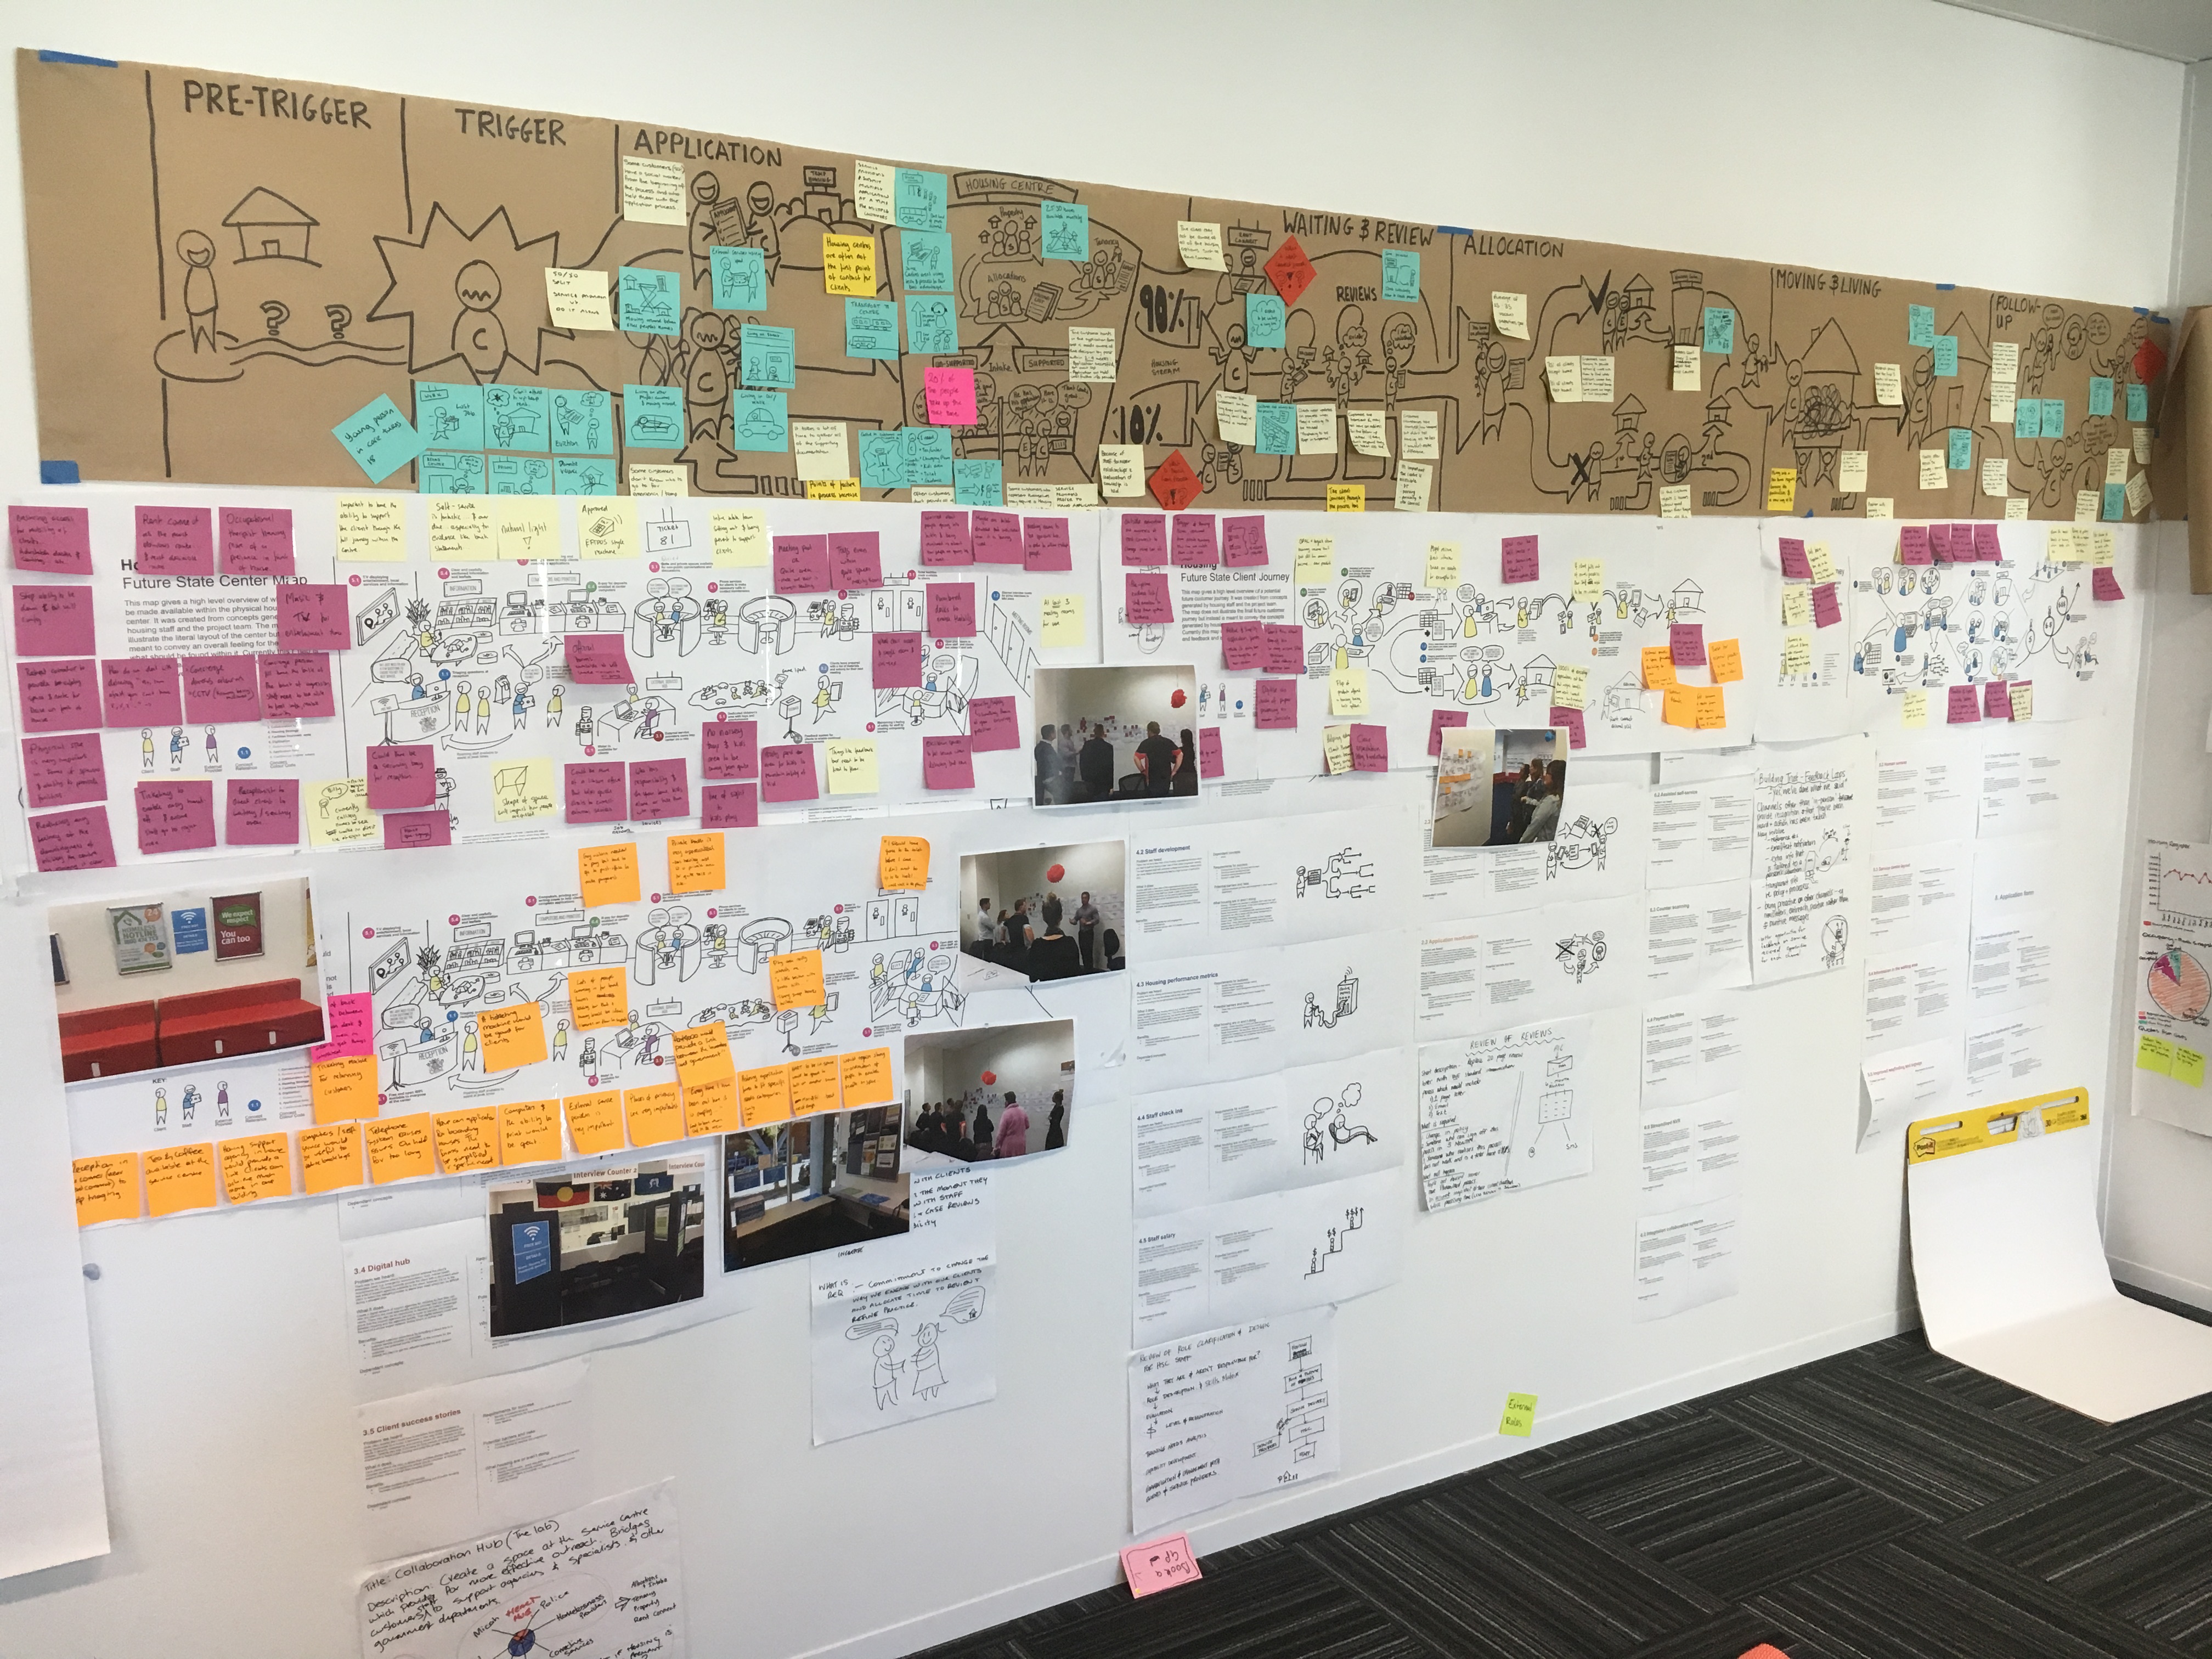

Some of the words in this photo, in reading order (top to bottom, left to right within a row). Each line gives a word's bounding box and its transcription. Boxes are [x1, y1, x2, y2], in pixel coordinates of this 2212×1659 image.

[183, 80, 372, 129] PRE-TRIGGER
[455, 108, 566, 146] TRIGGER
[634, 129, 782, 167] APPLICATION
[966, 179, 1006, 191] HOUSING
[1011, 183, 1055, 195] CENTRE
[1000, 207, 1023, 218] Property
[1283, 210, 1353, 238] WAITING
[1374, 222, 1434, 246] REVIEW
[827, 236, 849, 251] Housing
[1464, 235, 1564, 258] ALLOCATION
[856, 264, 871, 273] point
[1776, 272, 1825, 290] MOVING
[1841, 276, 1881, 297] LIVING
[1336, 286, 1378, 303] REVIEWS
[1140, 284, 1184, 332] 90%
[1996, 315, 2012, 330] UP
[989, 362, 1012, 372] Intake
[374, 408, 394, 426] person
[368, 436, 381, 447] care
[368, 455, 375, 465] 18
[661, 534, 674, 545] 81
[123, 577, 171, 590] Future
[176, 575, 215, 588] State
[219, 575, 268, 586] Center
[1181, 573, 1207, 582] Future
[1210, 572, 1231, 582] State
[1233, 572, 1256, 581] Client
[1259, 572, 1289, 583] Journey
[161, 599, 181, 607] gives
[190, 598, 206, 606] high
[232, 605, 262, 613] physical
[127, 627, 156, 635] housing
[1786, 772, 1798, 782] Trust
[233, 909, 253, 917] expect
[123, 930, 157, 938] HOTLINE
[1167, 975, 1199, 984] performance
[1470, 1038, 1497, 1049] REVIEW
[1521, 1028, 1552, 1040] REVIEWS
[573, 1170, 606, 1178] Interview
[935, 1167, 970, 1179] CLIENTS
[940, 1191, 963, 1200] STAFF
[368, 1261, 393, 1272] Digital
[1508, 1398, 1533, 1413] External
[377, 1423, 399, 1433] Client
[401, 1415, 433, 1427] success
[435, 1409, 461, 1420] stories
[610, 1519, 650, 1537] Bridges
[395, 1549, 471, 1579] Collaboration
[476, 1540, 503, 1553] Hub
[367, 1584, 434, 1611] Description:
[440, 1567, 478, 1587] Create
[503, 1548, 534, 1564] space
[542, 1539, 555, 1550] at
[540, 1592, 569, 1609] Police
[556, 1594, 605, 1621] Homelessness
[634, 1599, 660, 1612] Property
